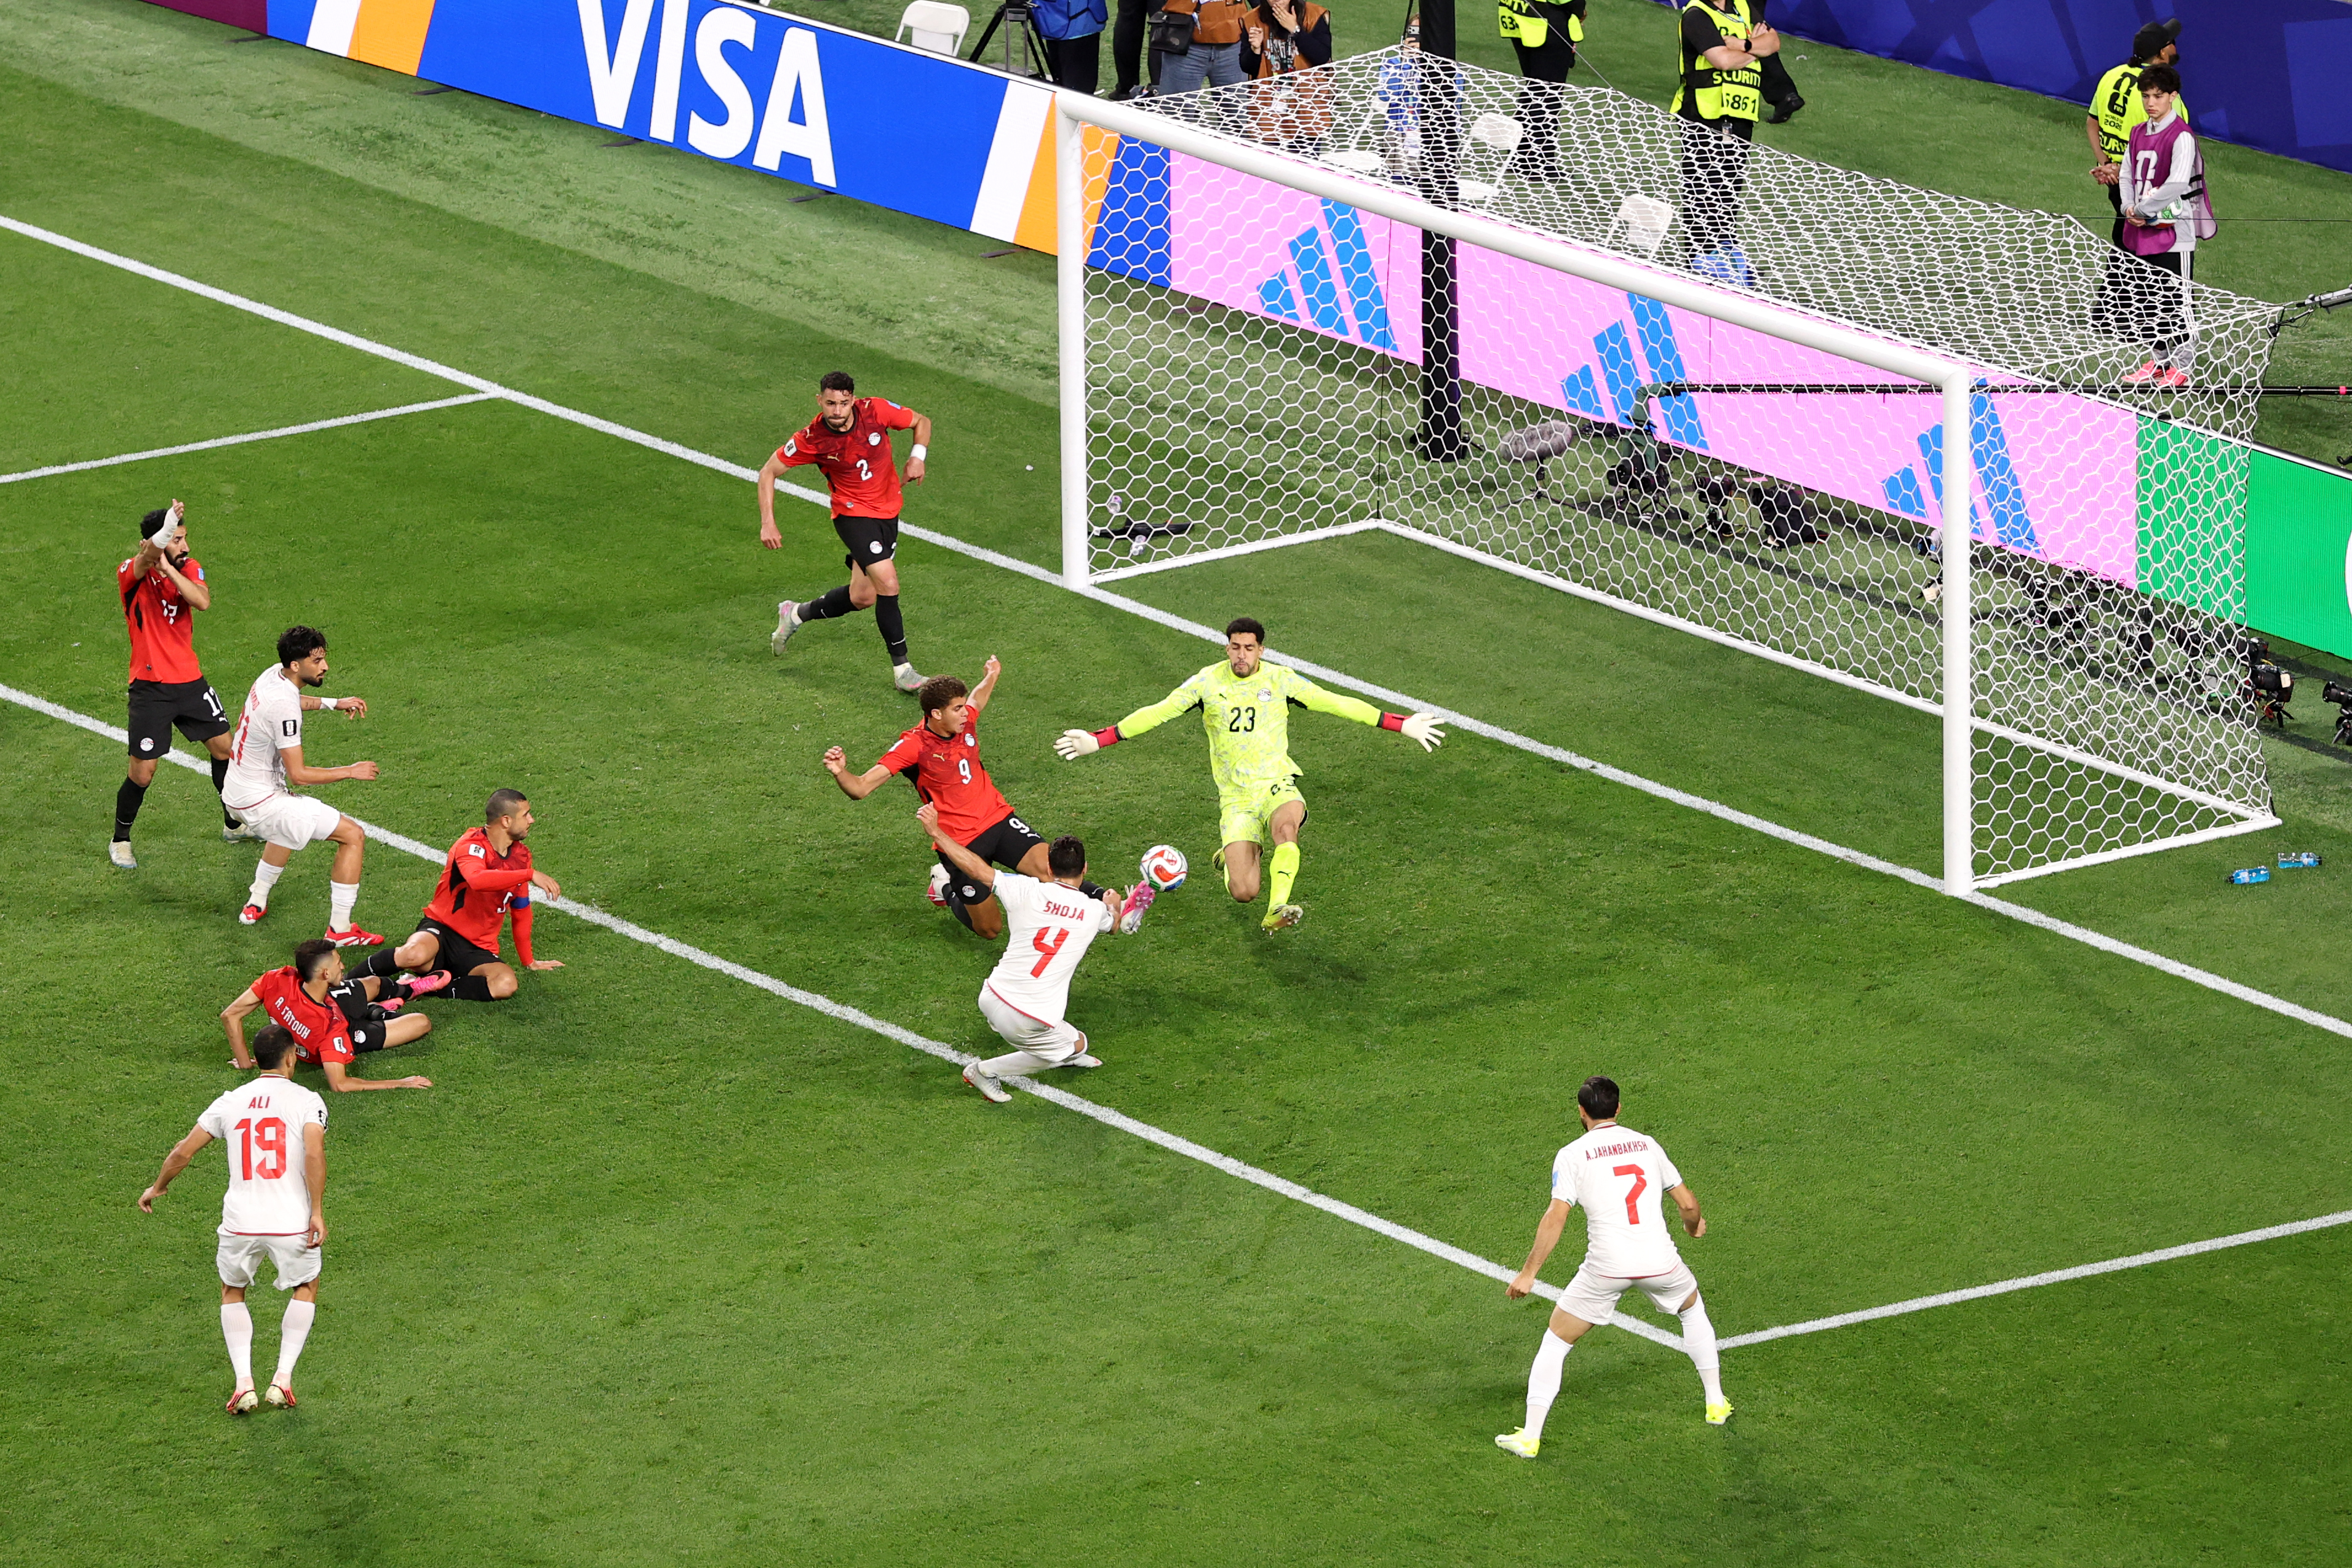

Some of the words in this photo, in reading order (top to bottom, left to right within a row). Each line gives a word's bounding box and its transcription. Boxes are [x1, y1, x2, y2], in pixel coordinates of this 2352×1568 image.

[577, 0, 837, 188] VISA
[2104, 118, 2122, 131] 2026
[856, 459, 872, 481] 2
[161, 599, 178, 625] 17
[203, 686, 223, 717] 17
[1229, 707, 1256, 732] 23
[959, 758, 972, 784] 9
[1009, 818, 1030, 834] 9
[1043, 901, 1085, 921] SHOJA
[1030, 926, 1069, 979] 4
[248, 1096, 270, 1108] ALI
[234, 1116, 287, 1180] 19
[1613, 1164, 1647, 1225] 7
